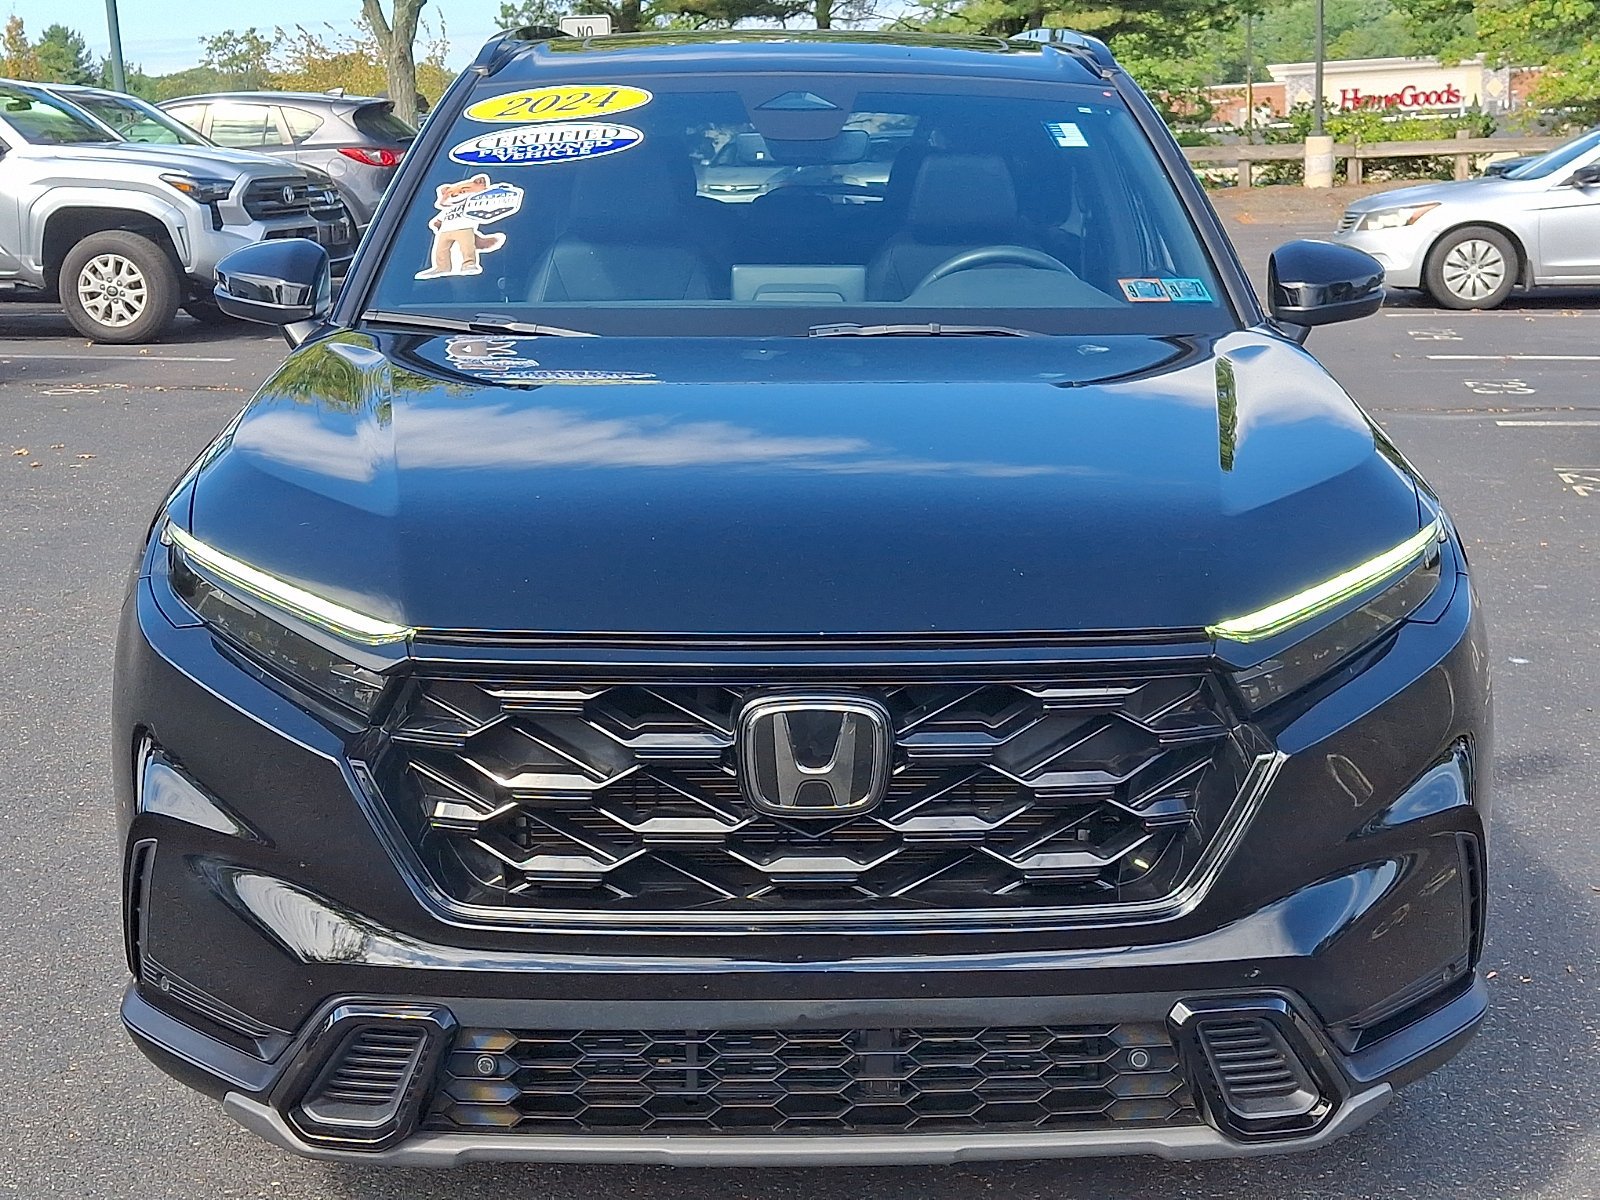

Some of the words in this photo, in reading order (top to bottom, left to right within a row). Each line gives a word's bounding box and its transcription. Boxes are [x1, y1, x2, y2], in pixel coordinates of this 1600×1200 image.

[577, 26, 594, 37] NO
[495, 90, 619, 117] 2024
[1340, 83, 1460, 111] HomeGoods
[476, 128, 621, 148] CERTIFIED
[478, 139, 613, 157] PRE-OWNED
[497, 148, 591, 162] VEHICLE
[1127, 285, 1138, 298] 9
[1169, 285, 1181, 298] 9
